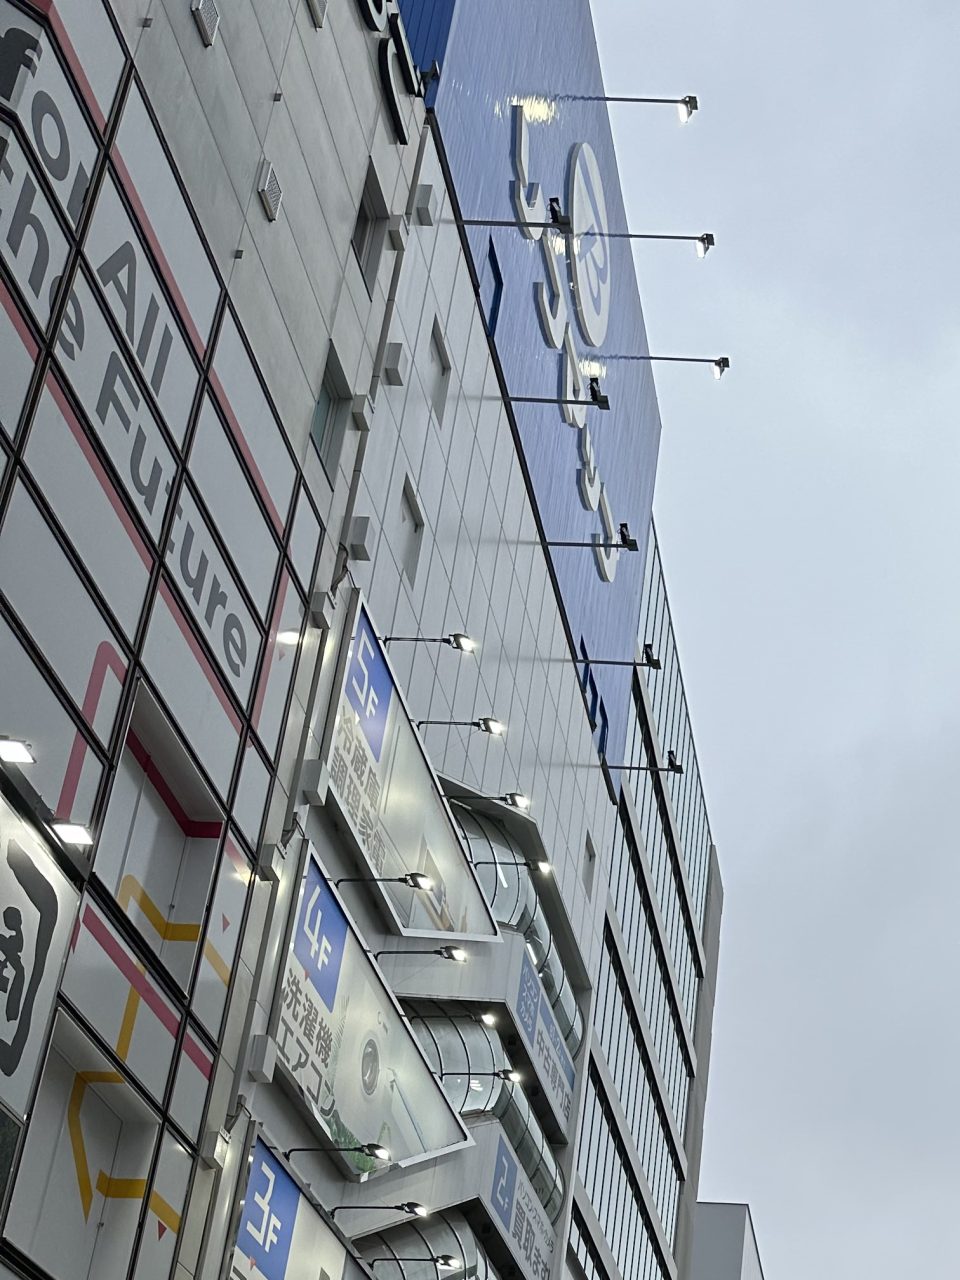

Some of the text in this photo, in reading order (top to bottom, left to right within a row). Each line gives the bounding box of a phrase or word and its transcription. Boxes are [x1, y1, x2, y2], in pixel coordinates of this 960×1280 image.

[97, 240, 173, 394] All
[97, 353, 248, 678] Future
[352, 628, 379, 719] 5F
[303, 885, 332, 971] 4F
[276, 1016, 336, 1117] エアコン
[281, 968, 333, 1069] 洗濯機
[246, 1161, 281, 1253] 3F
